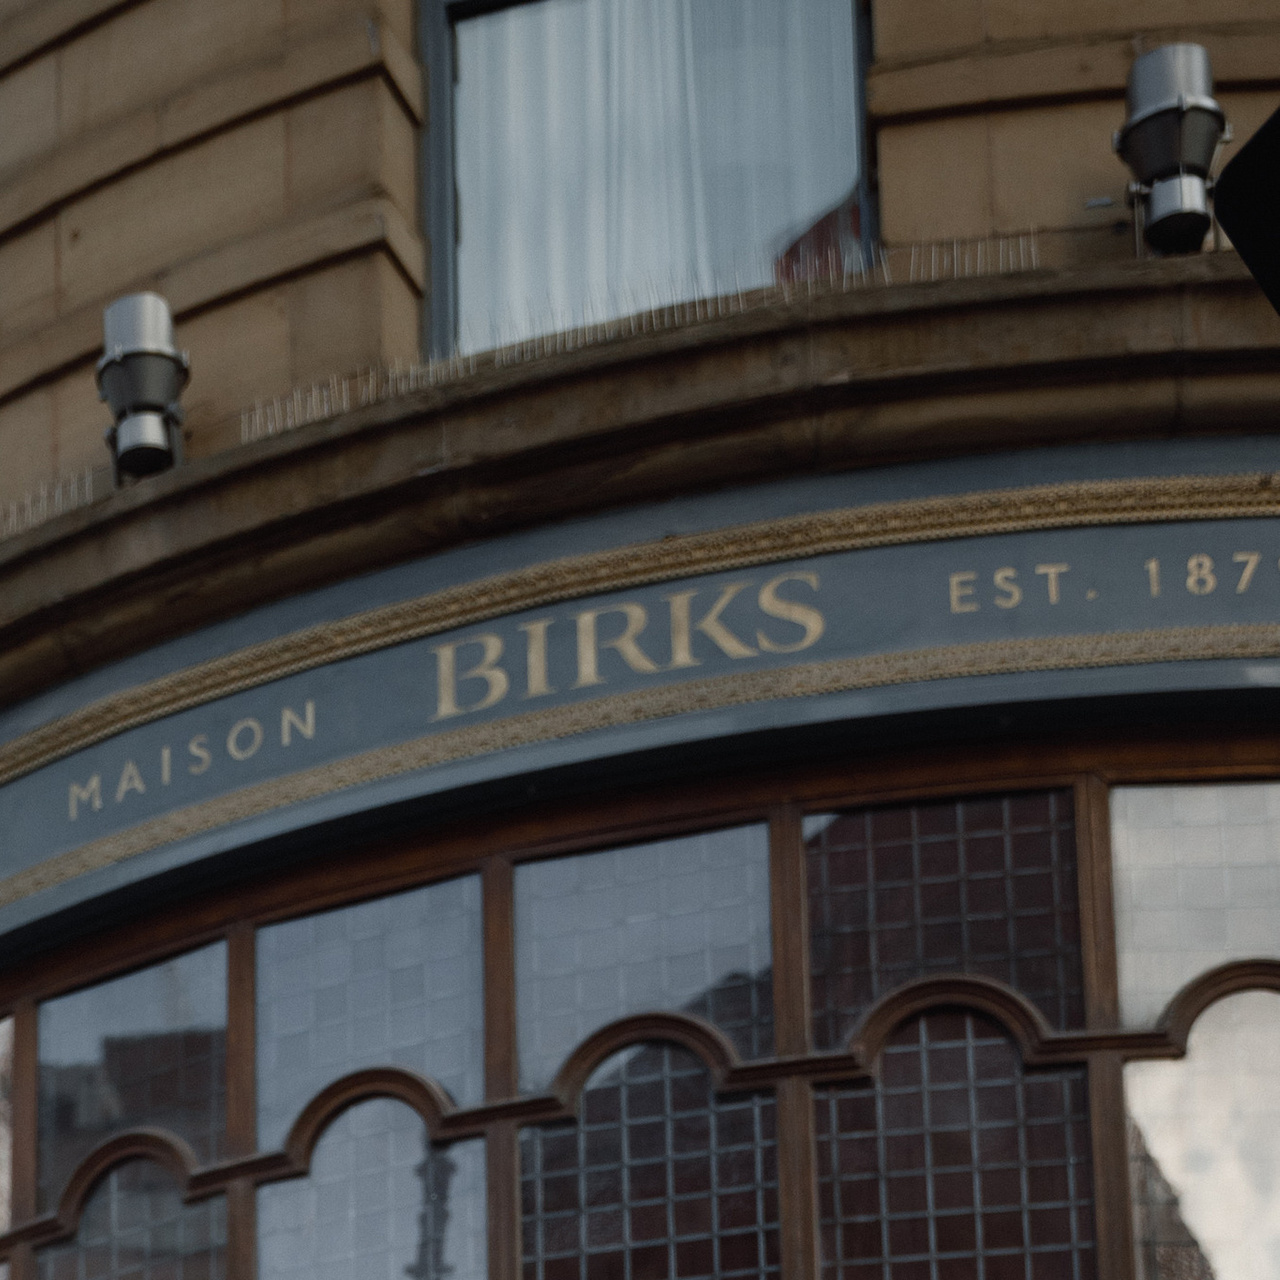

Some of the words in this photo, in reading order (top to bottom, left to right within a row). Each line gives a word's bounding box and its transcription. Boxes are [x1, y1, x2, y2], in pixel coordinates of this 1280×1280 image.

[67, 700, 318, 821] MAISON
[428, 571, 826, 723] BIRKS
[948, 563, 1098, 614] EST.
[1144, 551, 1280, 598] 187
